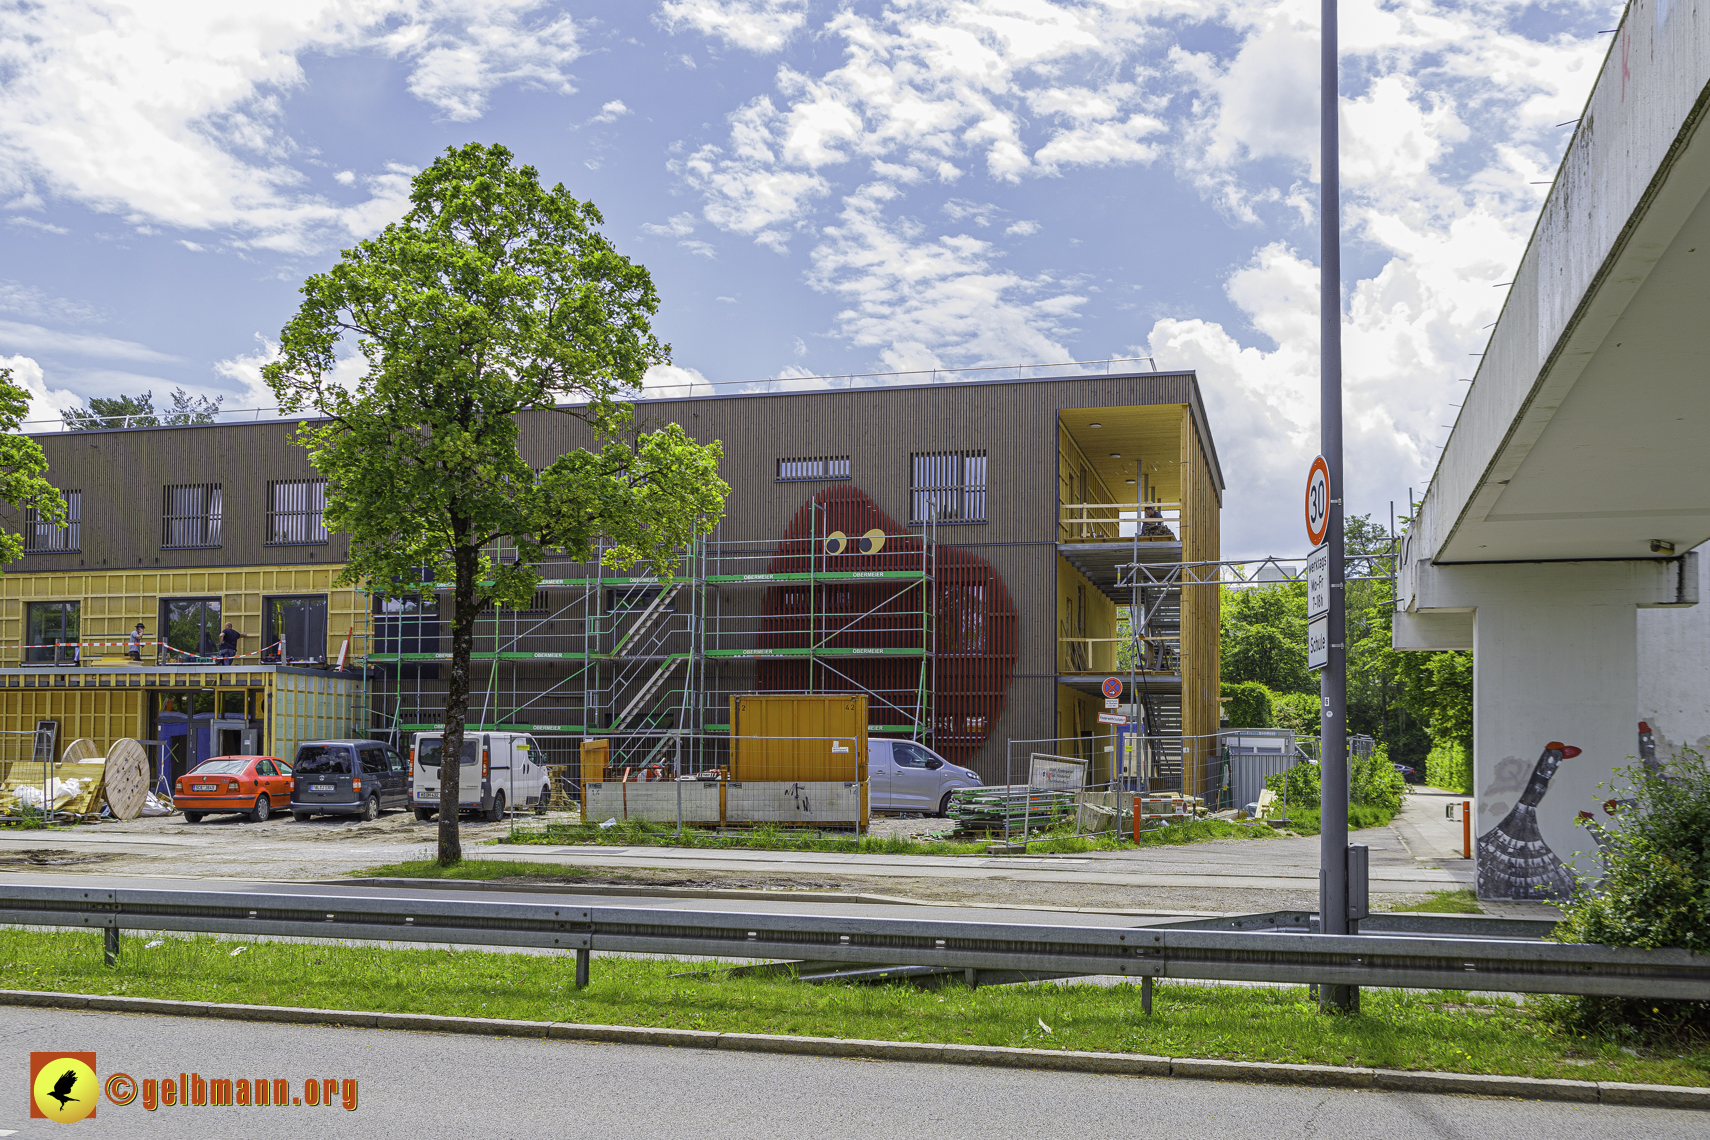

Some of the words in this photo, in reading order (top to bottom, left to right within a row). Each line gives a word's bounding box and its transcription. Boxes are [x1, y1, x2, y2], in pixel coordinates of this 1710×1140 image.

[1310, 479, 1325, 524] 30
[1308, 556, 1327, 575] werktags
[1309, 633, 1326, 654] Schule
